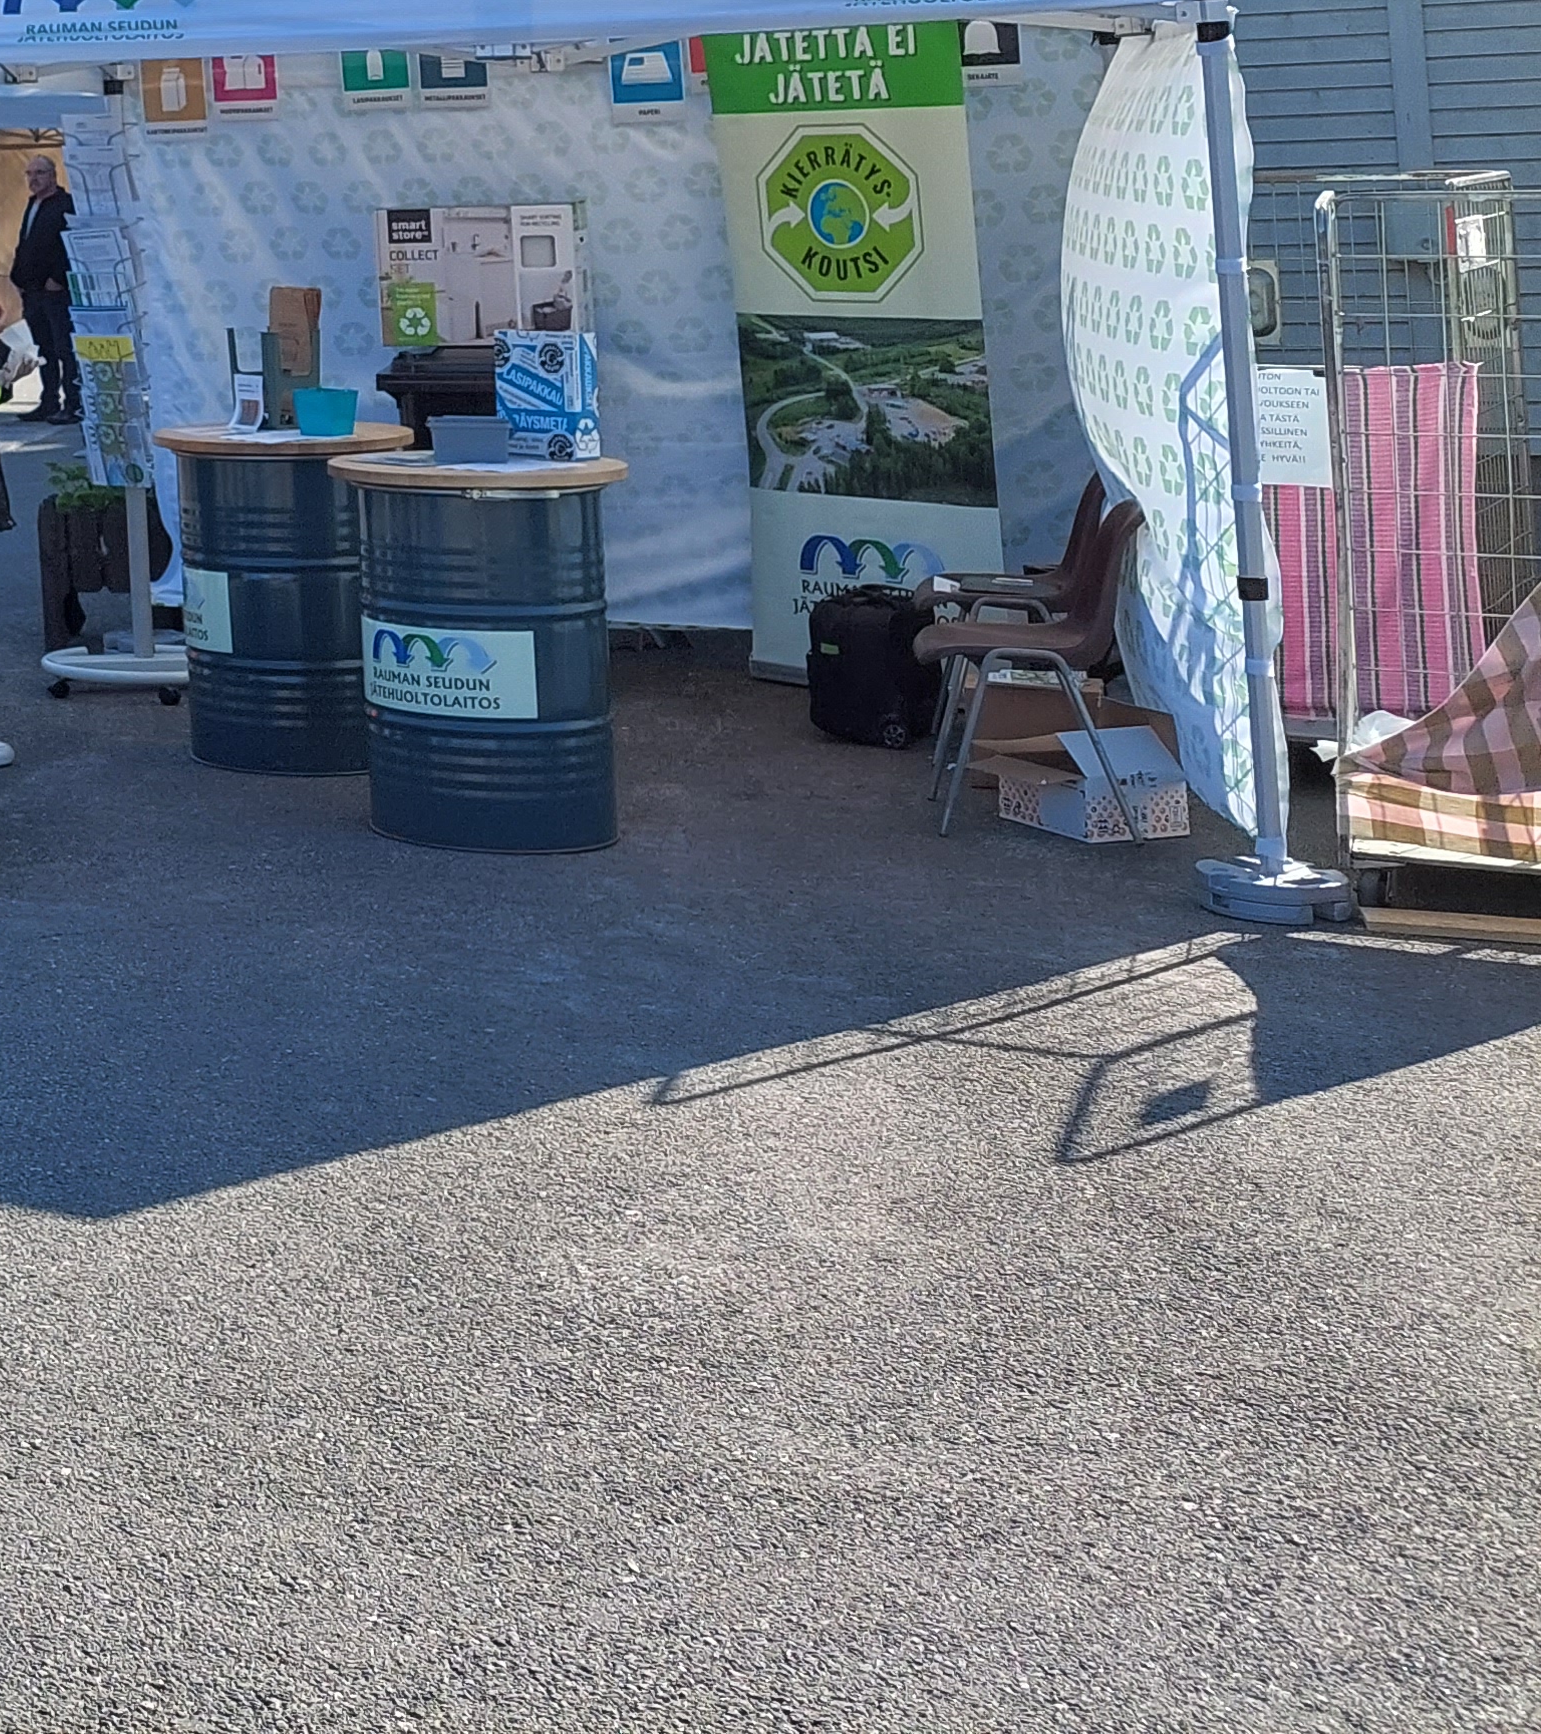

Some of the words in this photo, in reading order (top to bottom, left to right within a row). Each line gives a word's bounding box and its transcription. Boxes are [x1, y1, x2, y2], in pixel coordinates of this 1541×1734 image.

[26, 21, 103, 35] RAUMAN
[887, 24, 916, 57] EI
[768, 59, 891, 105] JÄTETÄ
[391, 219, 426, 230] smart
[389, 249, 439, 261] COLLECT
[801, 245, 890, 281] KOUTSI
[1258, 386, 1302, 396] OLTOON
[1304, 387, 1320, 397] TAI
[373, 666, 421, 686] RAUMAN
[425, 675, 491, 692] SEUDUN
[370, 680, 501, 710] JÄTEHUOLTOLAITOS
